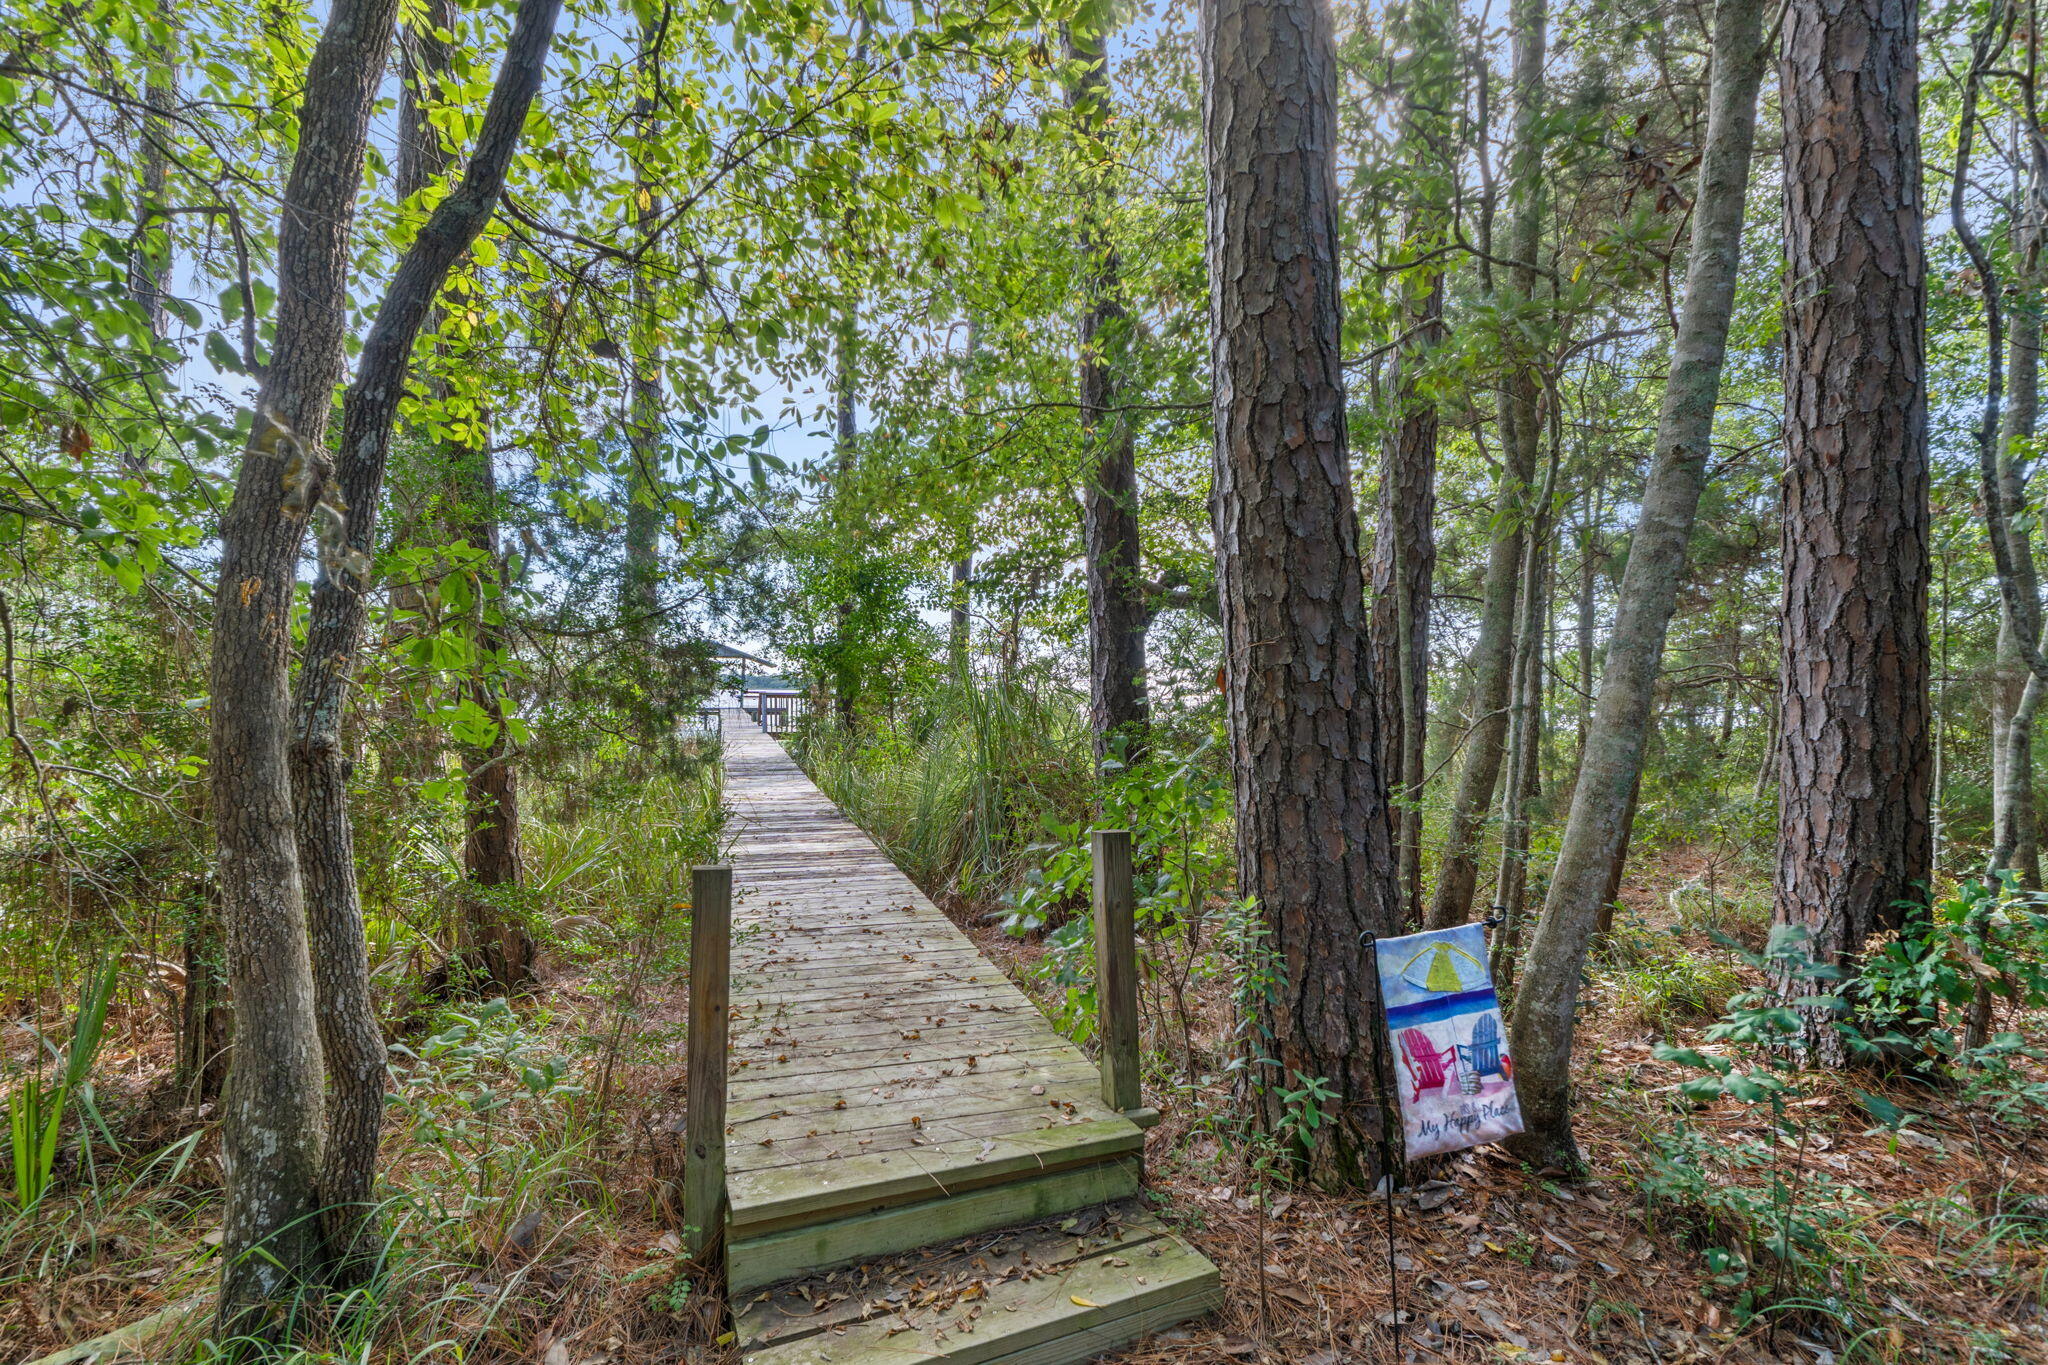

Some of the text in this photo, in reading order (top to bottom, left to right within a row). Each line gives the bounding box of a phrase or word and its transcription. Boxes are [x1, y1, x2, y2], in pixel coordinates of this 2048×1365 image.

[1417, 1101, 1510, 1140] My Happy Place
